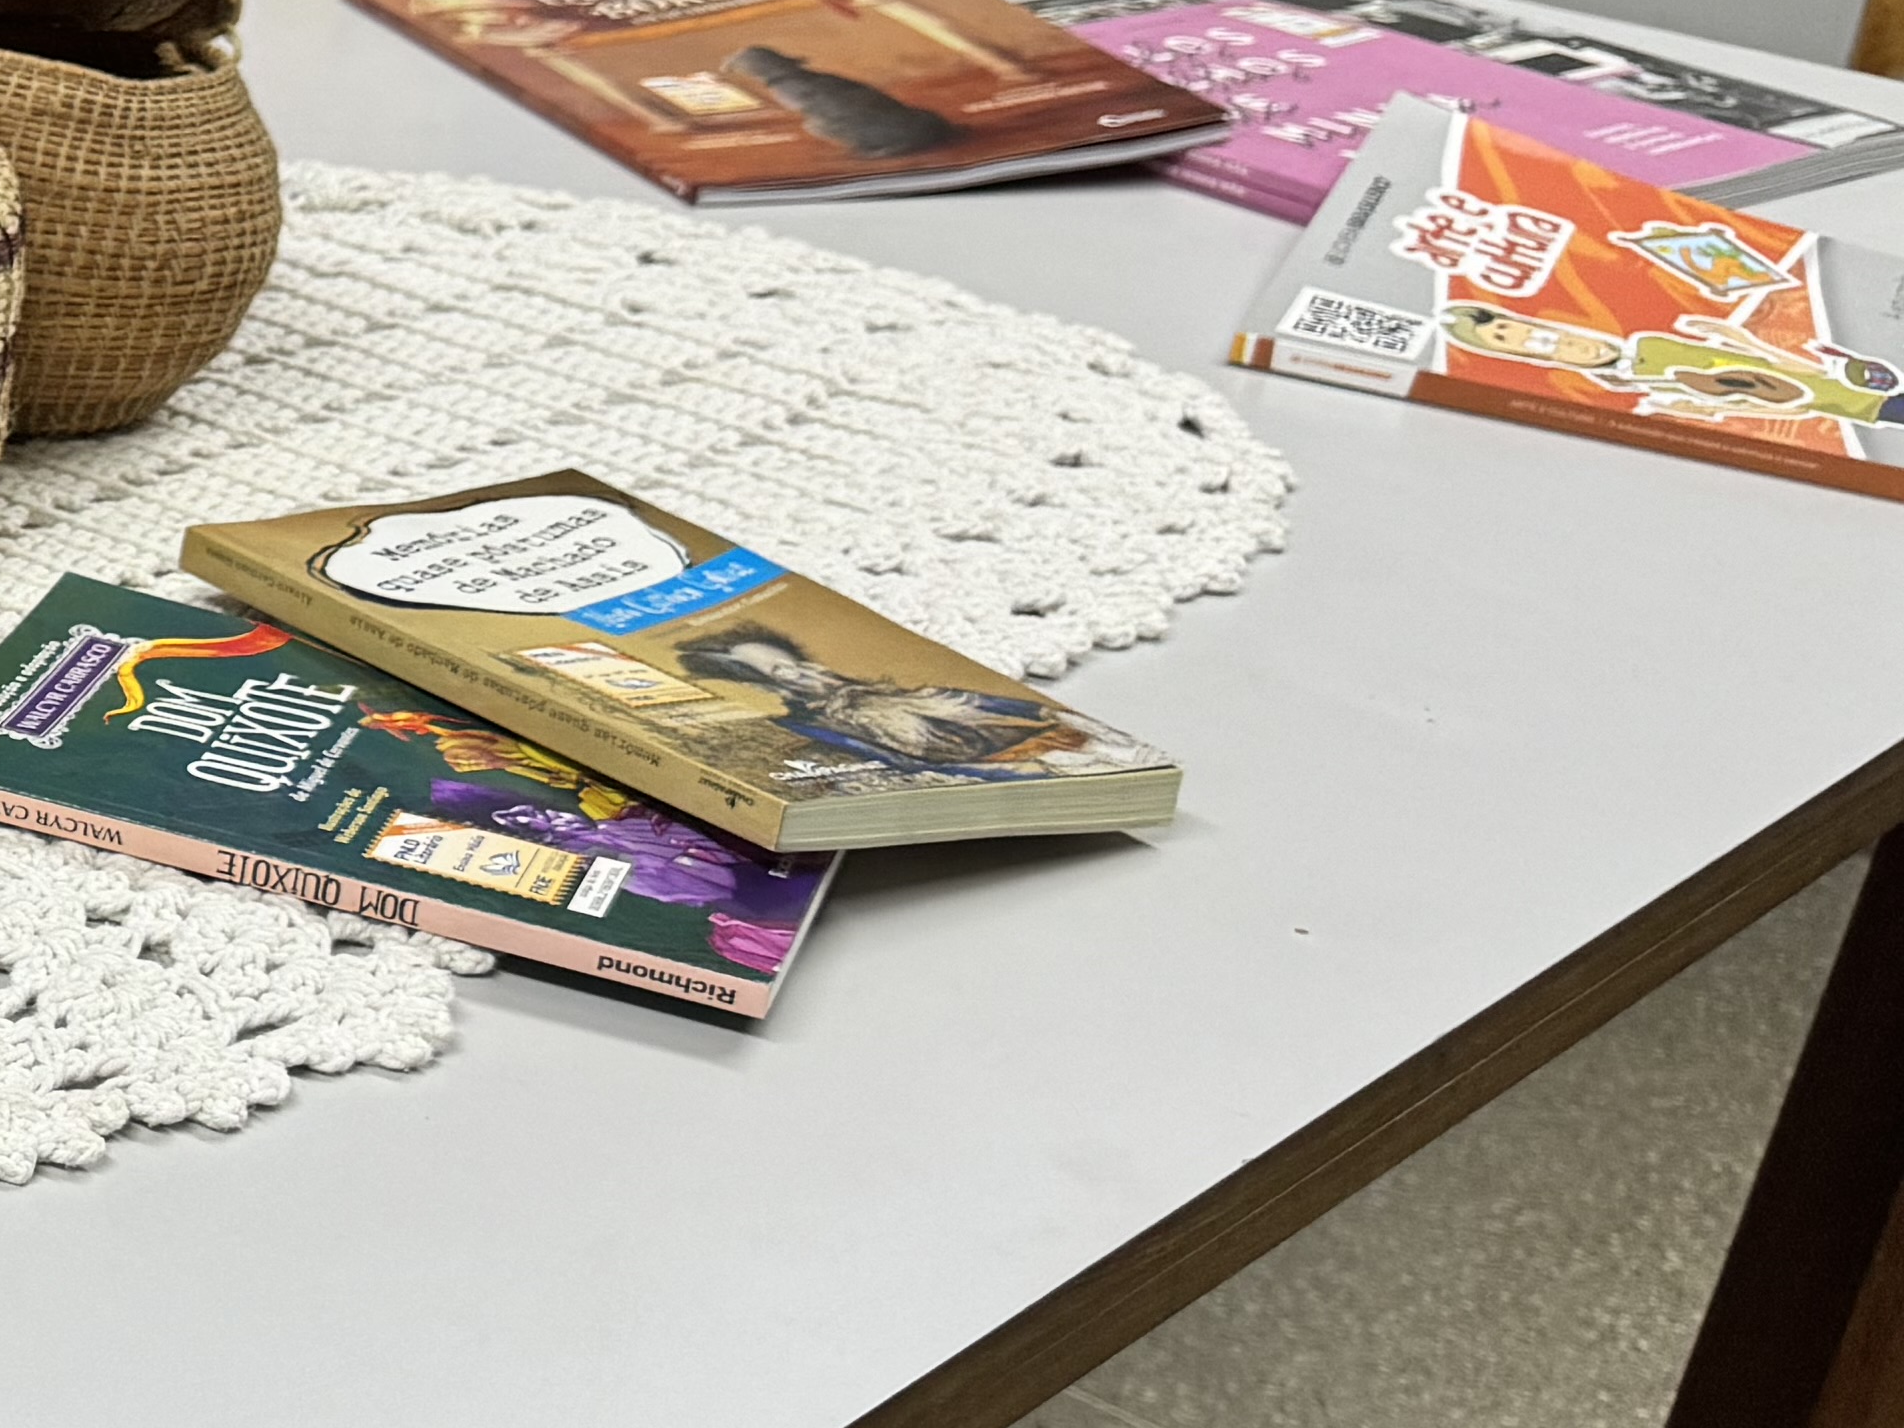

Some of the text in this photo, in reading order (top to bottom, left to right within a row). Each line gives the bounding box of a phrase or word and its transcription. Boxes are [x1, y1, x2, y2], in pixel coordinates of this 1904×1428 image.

[1479, 210, 1563, 291] cultura
[372, 513, 520, 561] Memórias
[377, 507, 607, 593] quase póstumas
[454, 536, 617, 595] de Machado
[514, 558, 649, 604] de Assis
[16, 643, 112, 731] WALCYR CARRASCO
[127, 679, 237, 744] DOM
[187, 673, 359, 793] QUIXOTE
[34, 808, 124, 847] WALCYR
[216, 850, 421, 928] DOM QUIXOTE
[597, 953, 736, 1006] Richmond
